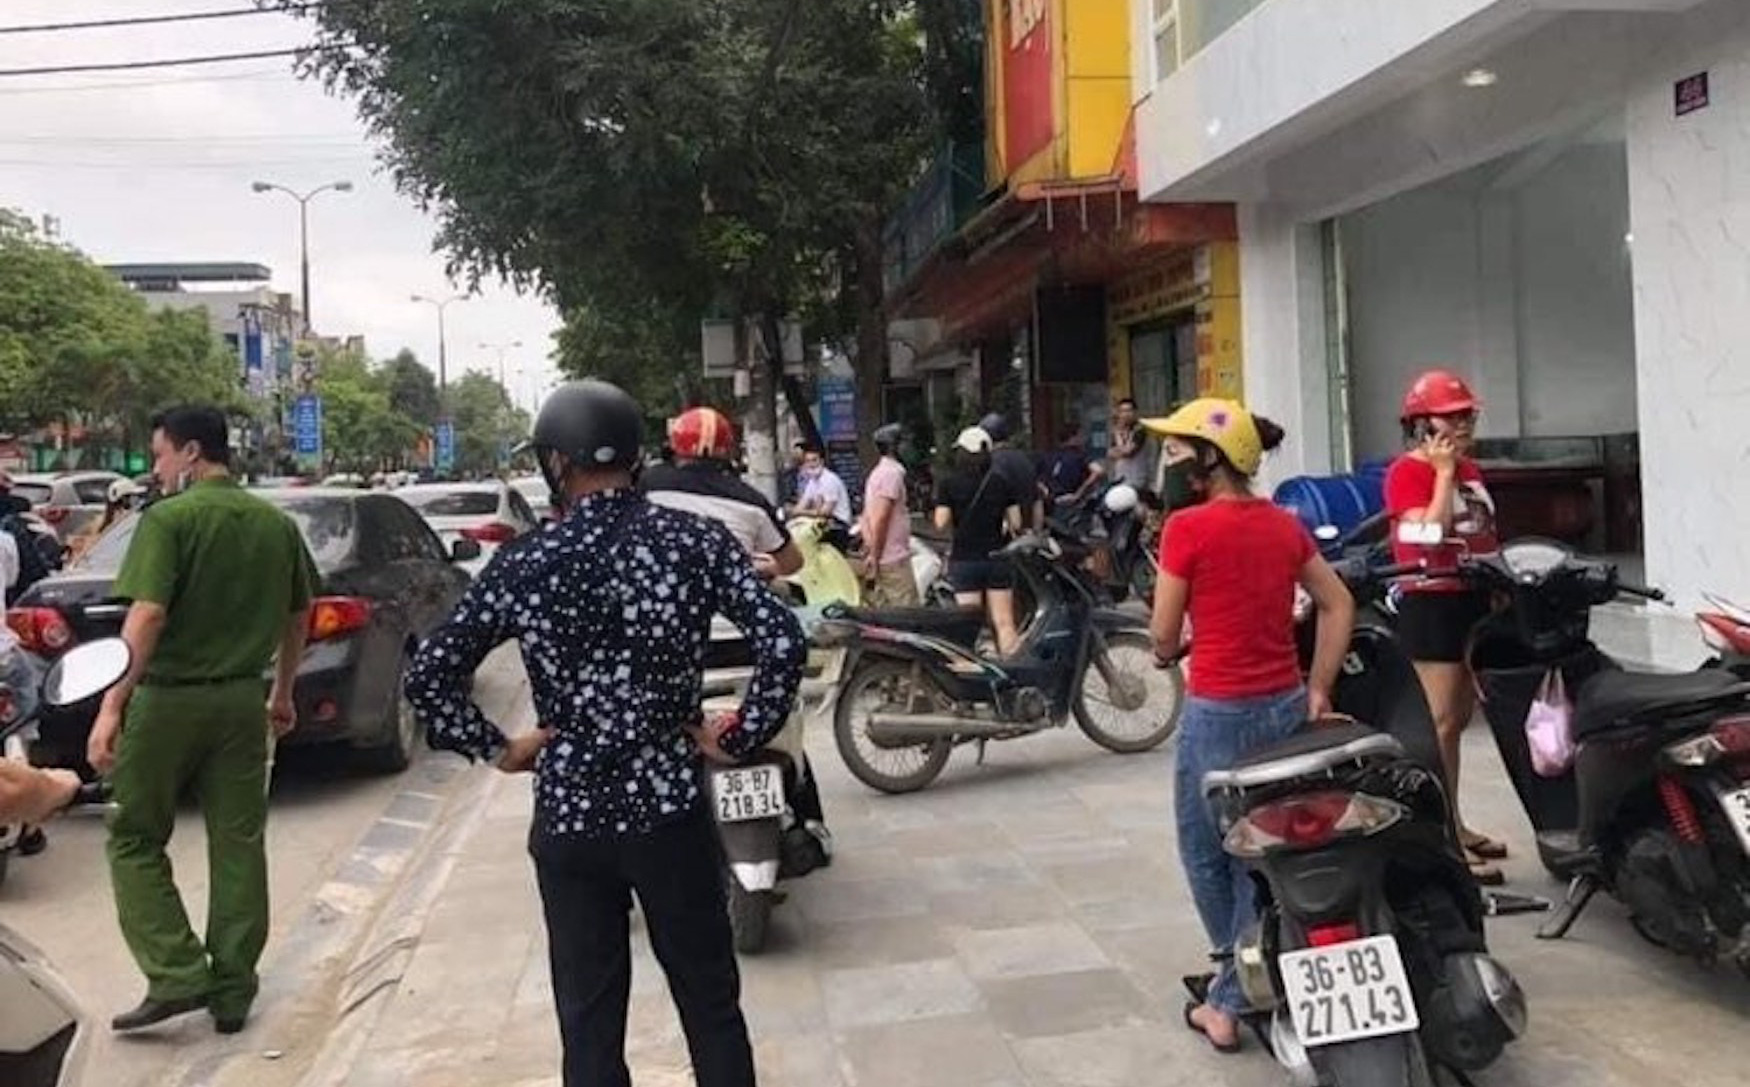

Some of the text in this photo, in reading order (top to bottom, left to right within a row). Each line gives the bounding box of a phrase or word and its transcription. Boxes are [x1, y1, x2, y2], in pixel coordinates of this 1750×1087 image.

[723, 769, 770, 794] 36-B7
[1298, 945, 1385, 993] 36-B3
[1300, 985, 1407, 1038] 271.43
